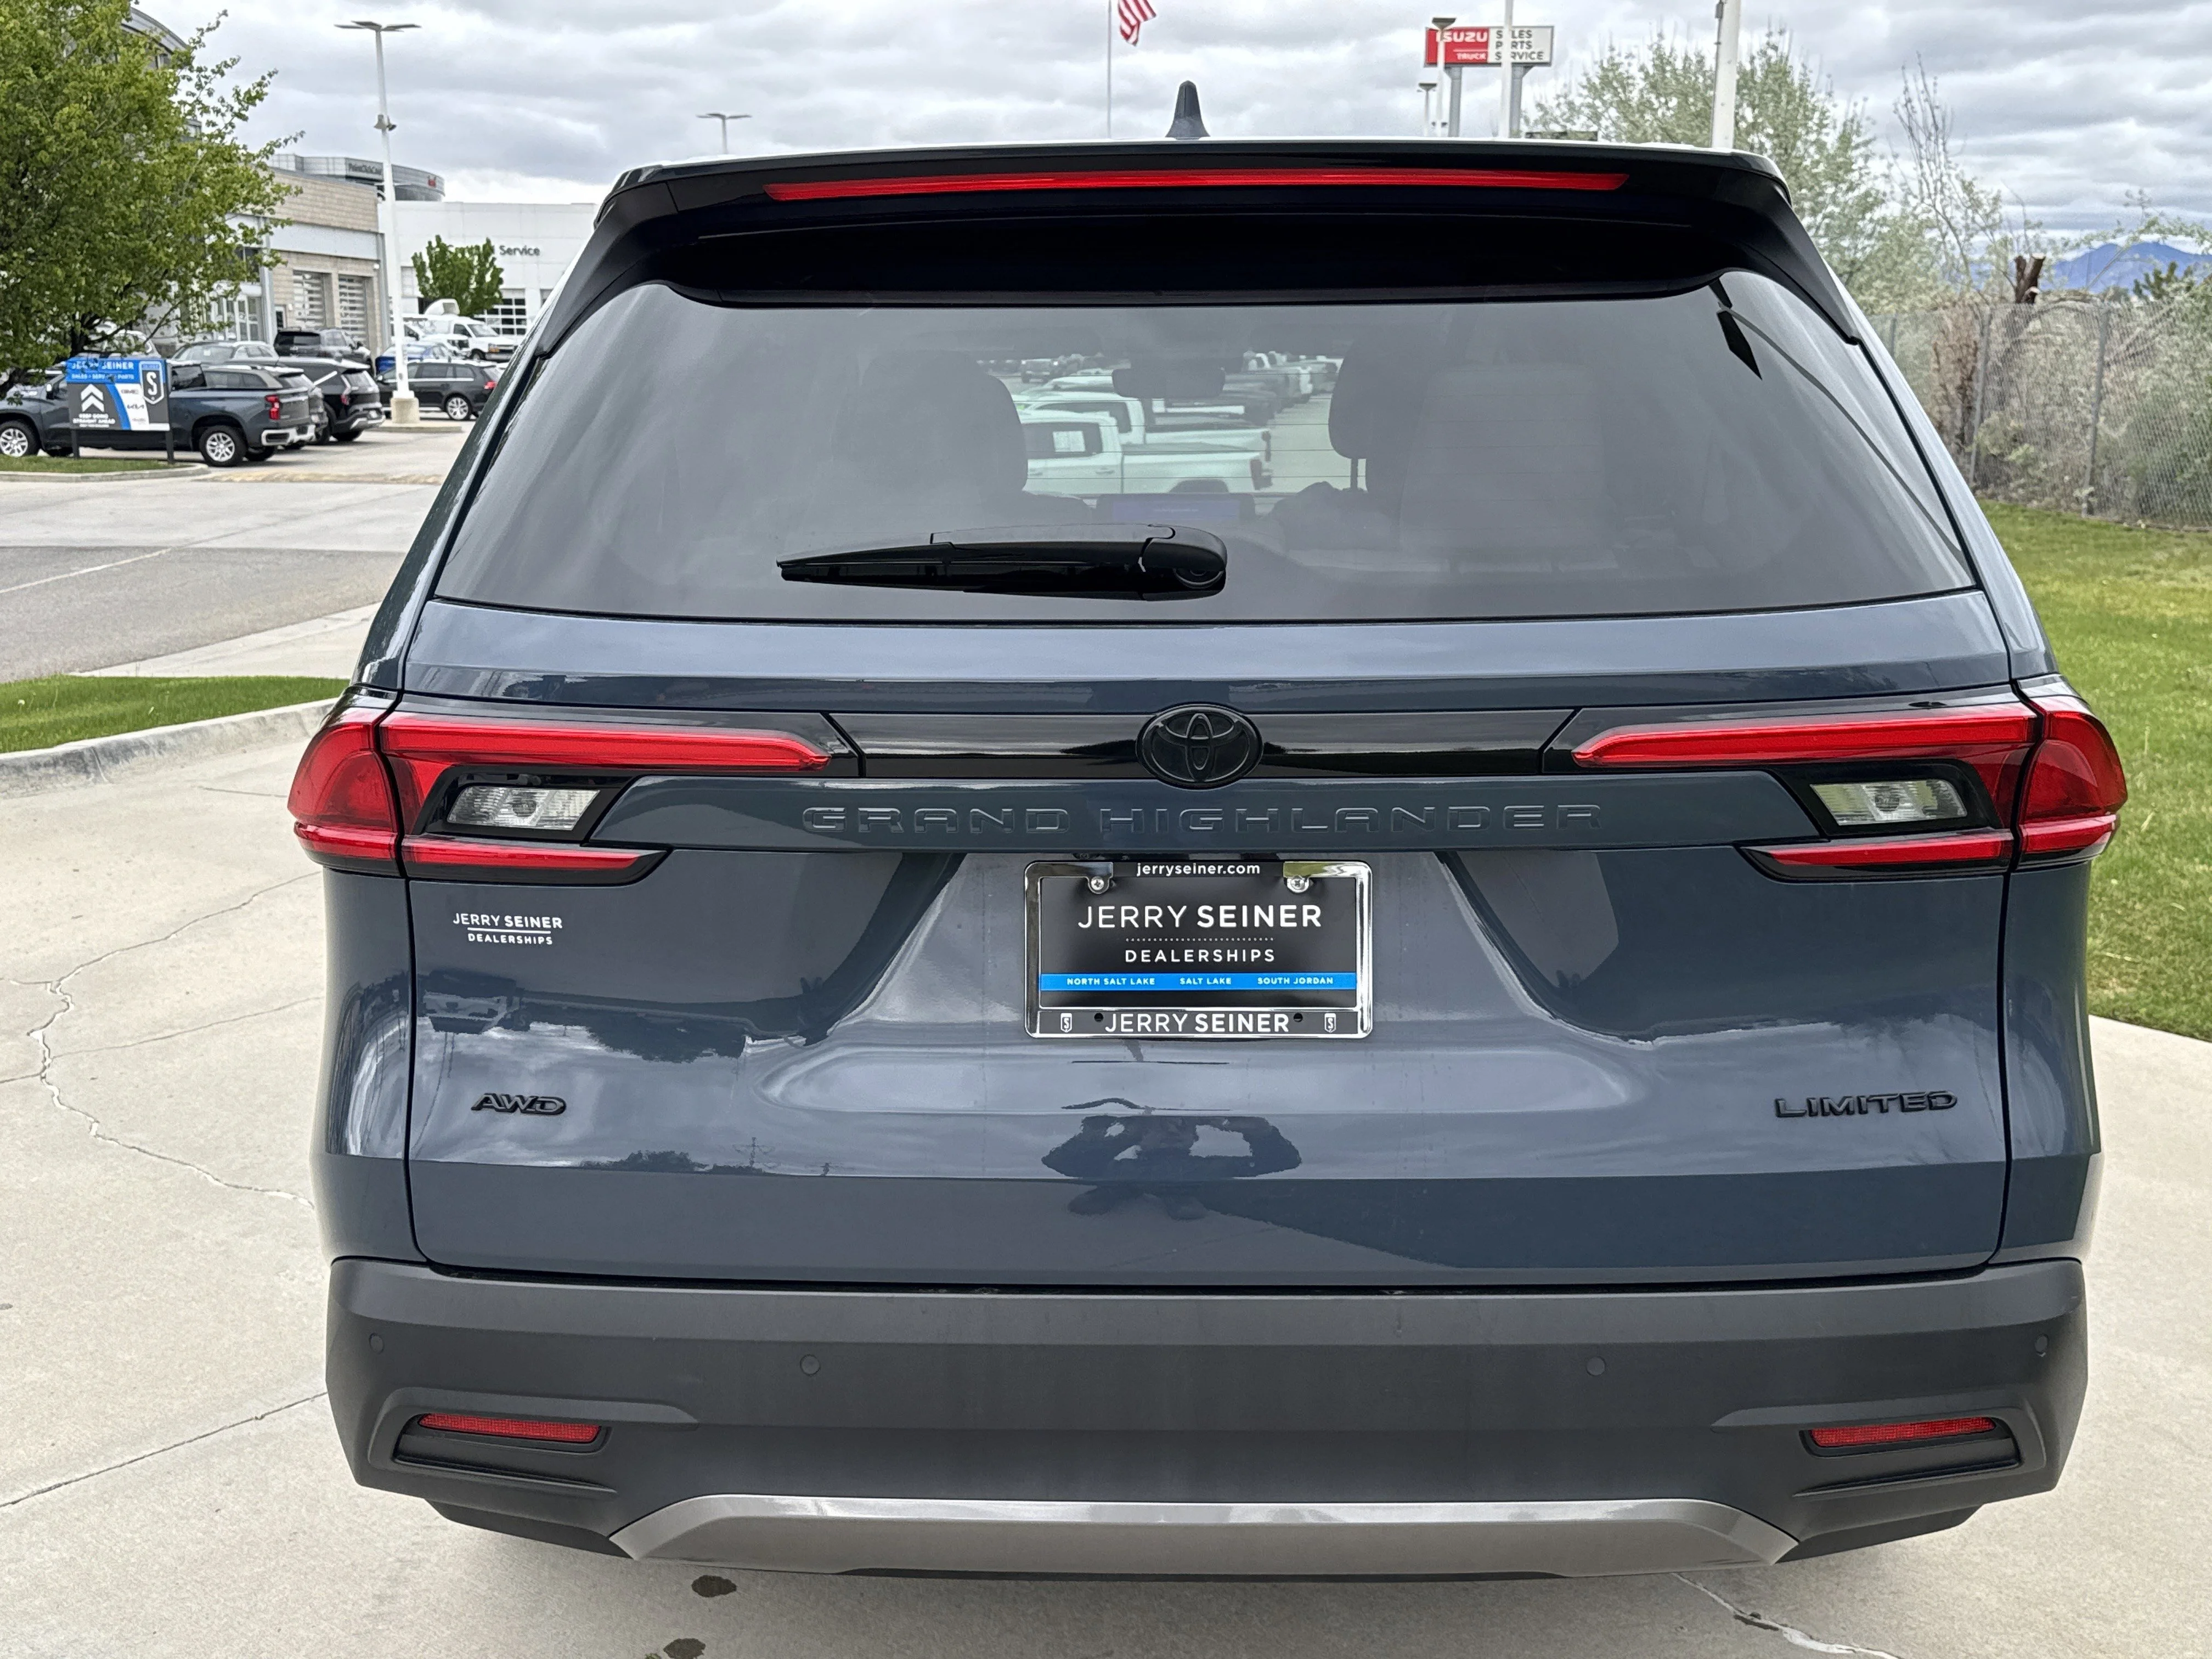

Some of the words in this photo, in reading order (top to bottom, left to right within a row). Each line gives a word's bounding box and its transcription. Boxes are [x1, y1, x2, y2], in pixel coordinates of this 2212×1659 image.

[1436, 31, 1487, 42] ISUZU
[1496, 30, 1532, 39] SLES
[1496, 41, 1532, 49] PRTS
[1495, 51, 1544, 60] SRVICE
[499, 245, 540, 256] Service
[802, 806, 1071, 833] GRAND
[1099, 804, 1602, 833] HIGHLANDER
[1136, 862, 1260, 877] jerryseiner.com
[453, 912, 500, 926] JERRY
[504, 915, 563, 929] SEINER
[1077, 905, 1187, 928] JERRY
[1197, 904, 1322, 928] SEINER
[467, 933, 553, 945] DEALERSHIPS
[1125, 949, 1275, 963] DEALERSHIPS
[1066, 978, 1101, 986] NORTH
[1206, 977, 1232, 985] LAKE
[1105, 1013, 1188, 1032] JERRY
[1194, 1013, 1289, 1032] SEINER
[470, 1092, 567, 1115] AWD
[1774, 1090, 1959, 1118] LIMITED
